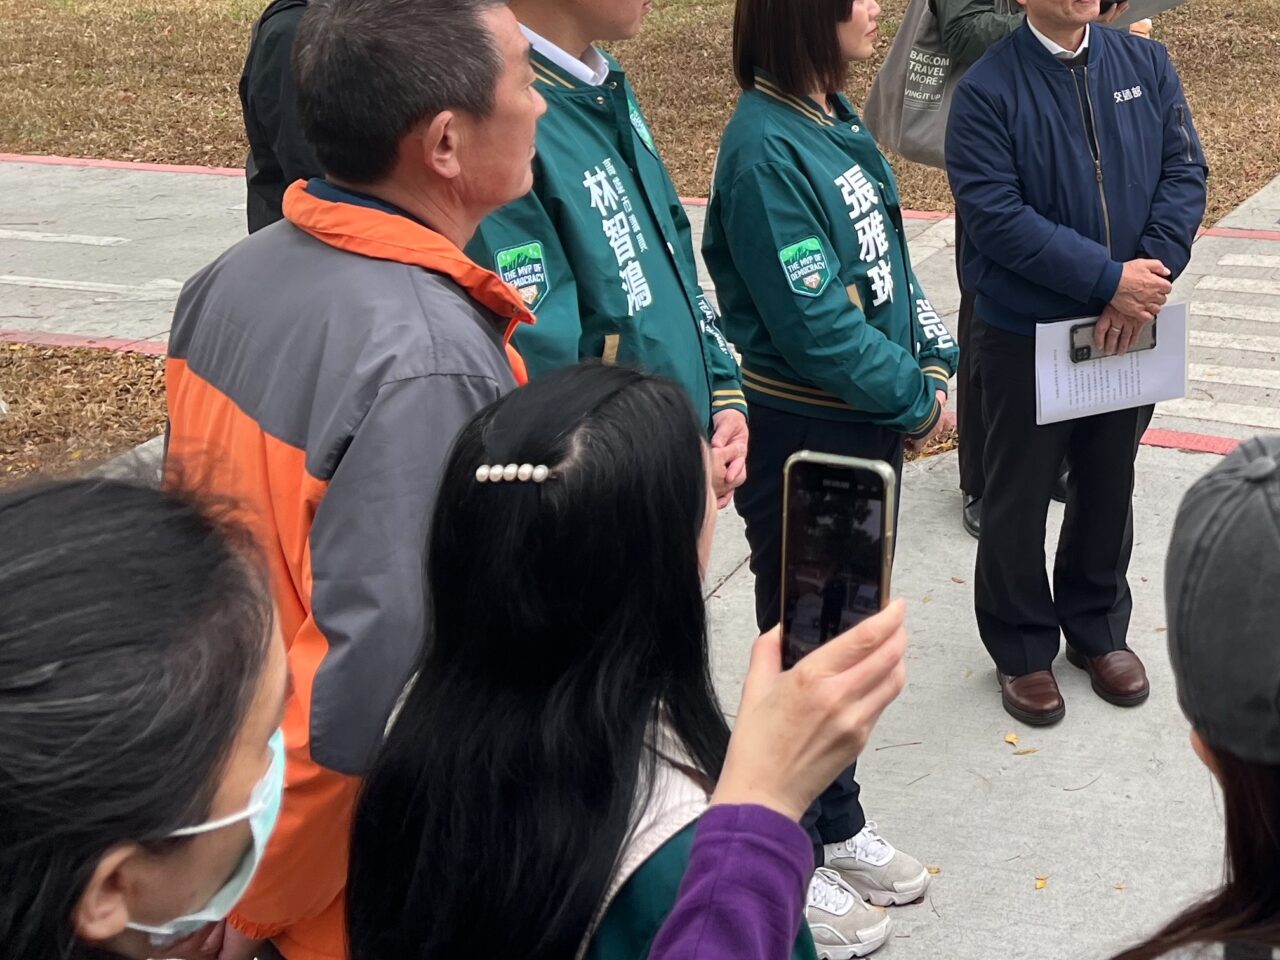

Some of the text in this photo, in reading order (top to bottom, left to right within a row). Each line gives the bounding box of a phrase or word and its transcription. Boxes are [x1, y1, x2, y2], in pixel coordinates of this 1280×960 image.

[909, 60, 945, 76] TRAVEL
[922, 92, 931, 101] IT
[1113, 85, 1143, 104] 交通部
[582, 165, 652, 317] 林智鴻
[834, 164, 894, 307] 張雅琳
[503, 263, 542, 282] THE MVP OF
[787, 253, 822, 273] THE MVP OF
[790, 262, 825, 281] DEMOCRACY
[509, 273, 545, 288] EMOCRACY
[916, 299, 954, 348] 2024
